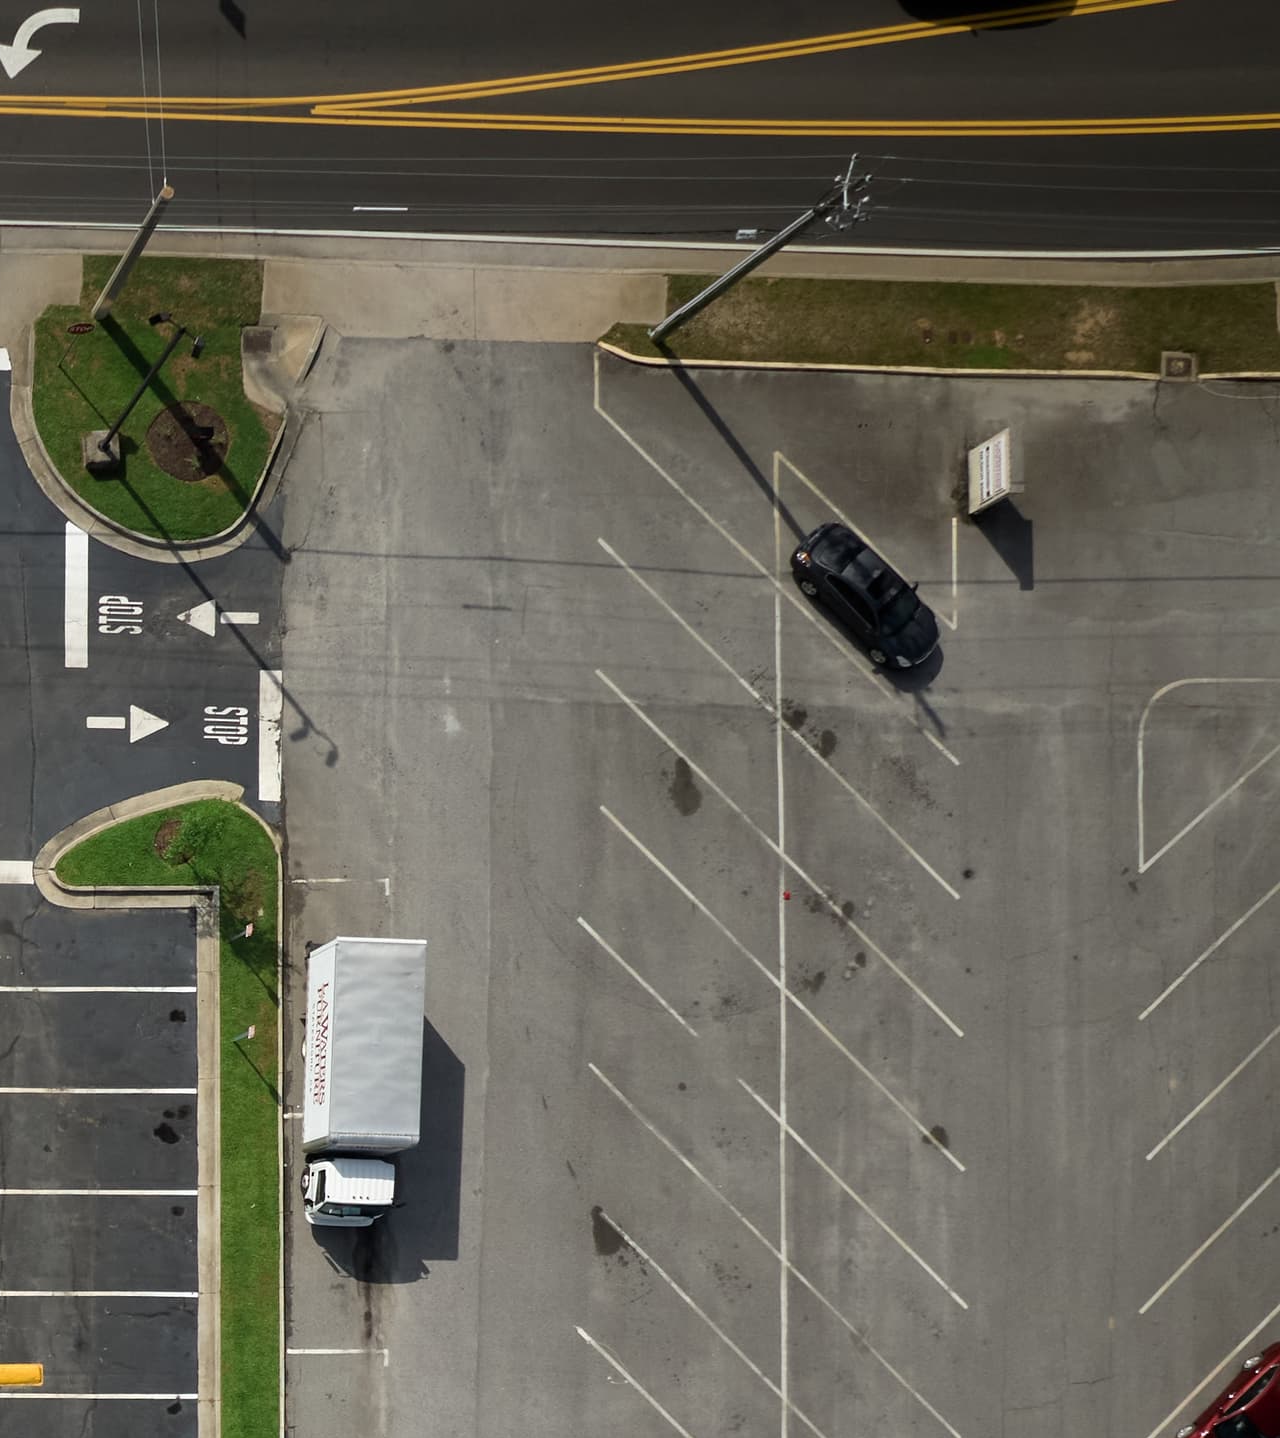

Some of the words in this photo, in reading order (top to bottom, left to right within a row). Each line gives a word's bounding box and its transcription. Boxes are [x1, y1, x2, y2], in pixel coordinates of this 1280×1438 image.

[98, 594, 144, 635] STOP
[203, 706, 249, 746] STOP
[313, 988, 322, 1105] FURNITURE
